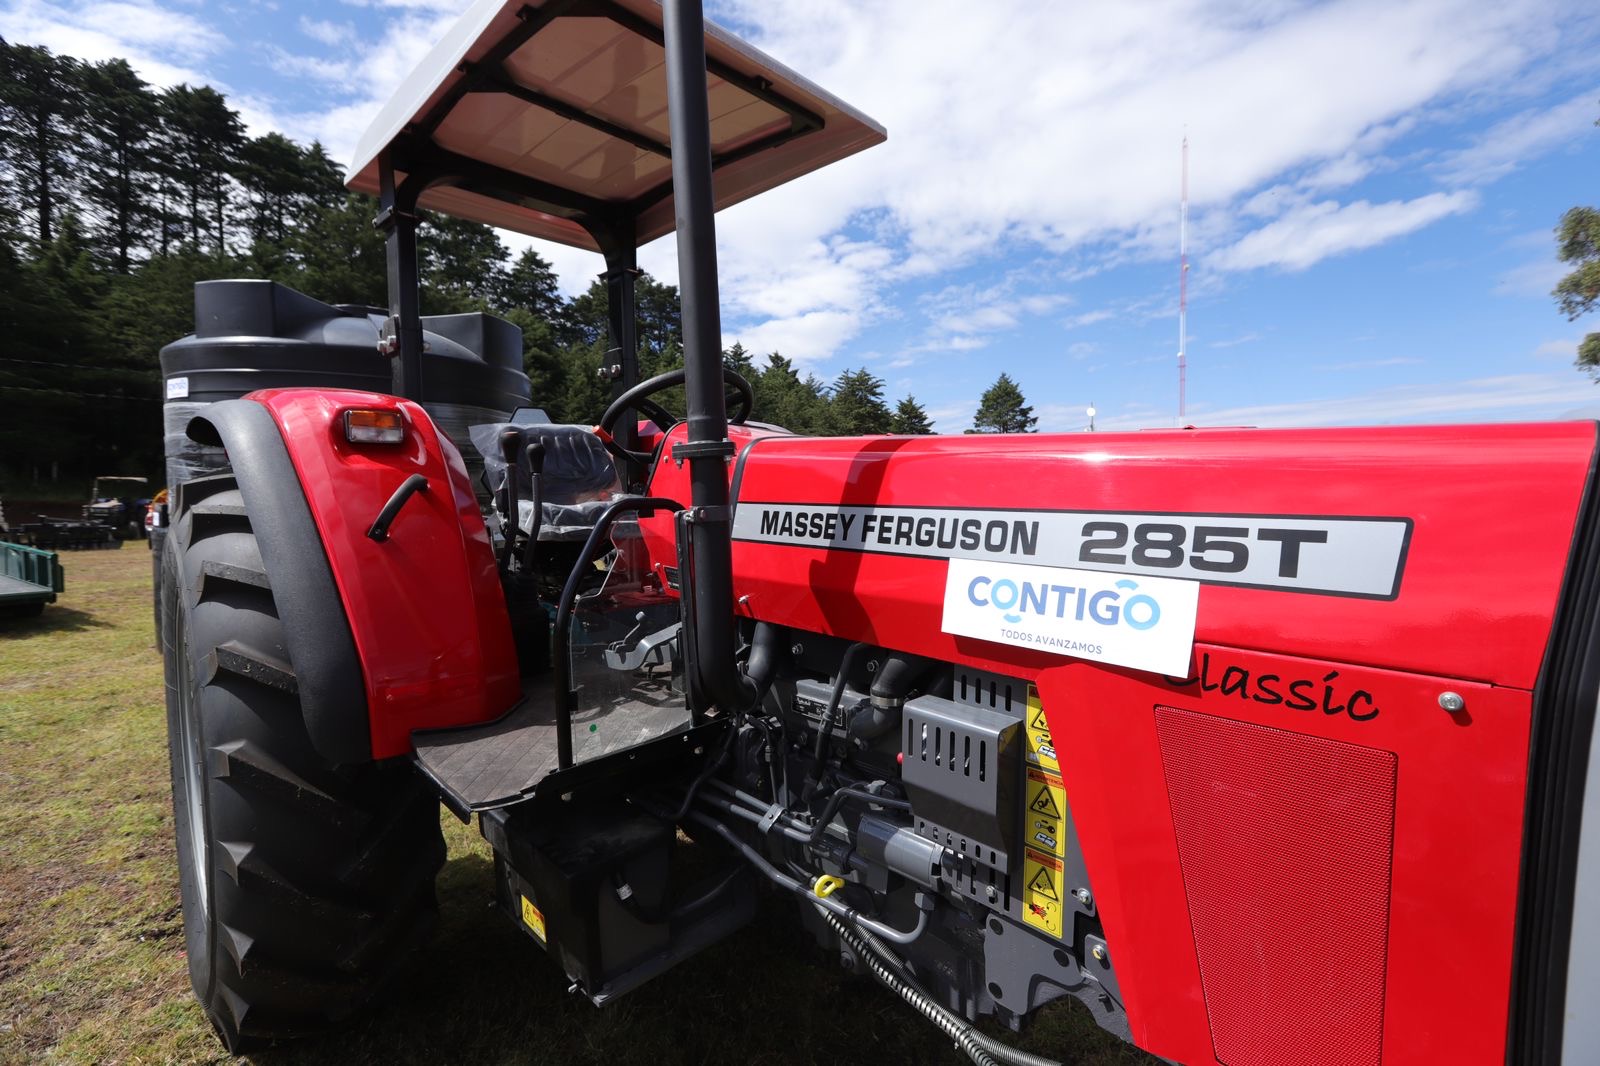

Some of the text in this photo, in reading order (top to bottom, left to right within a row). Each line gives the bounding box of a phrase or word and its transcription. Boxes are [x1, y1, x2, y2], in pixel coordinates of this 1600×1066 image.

[760, 510, 1328, 579] MASSEY FERGUSON 285T
[967, 575, 1161, 631] CONTIGO
[1001, 628, 1103, 655] TODOS AVANZAMOS
[1163, 653, 1379, 722] lassic
